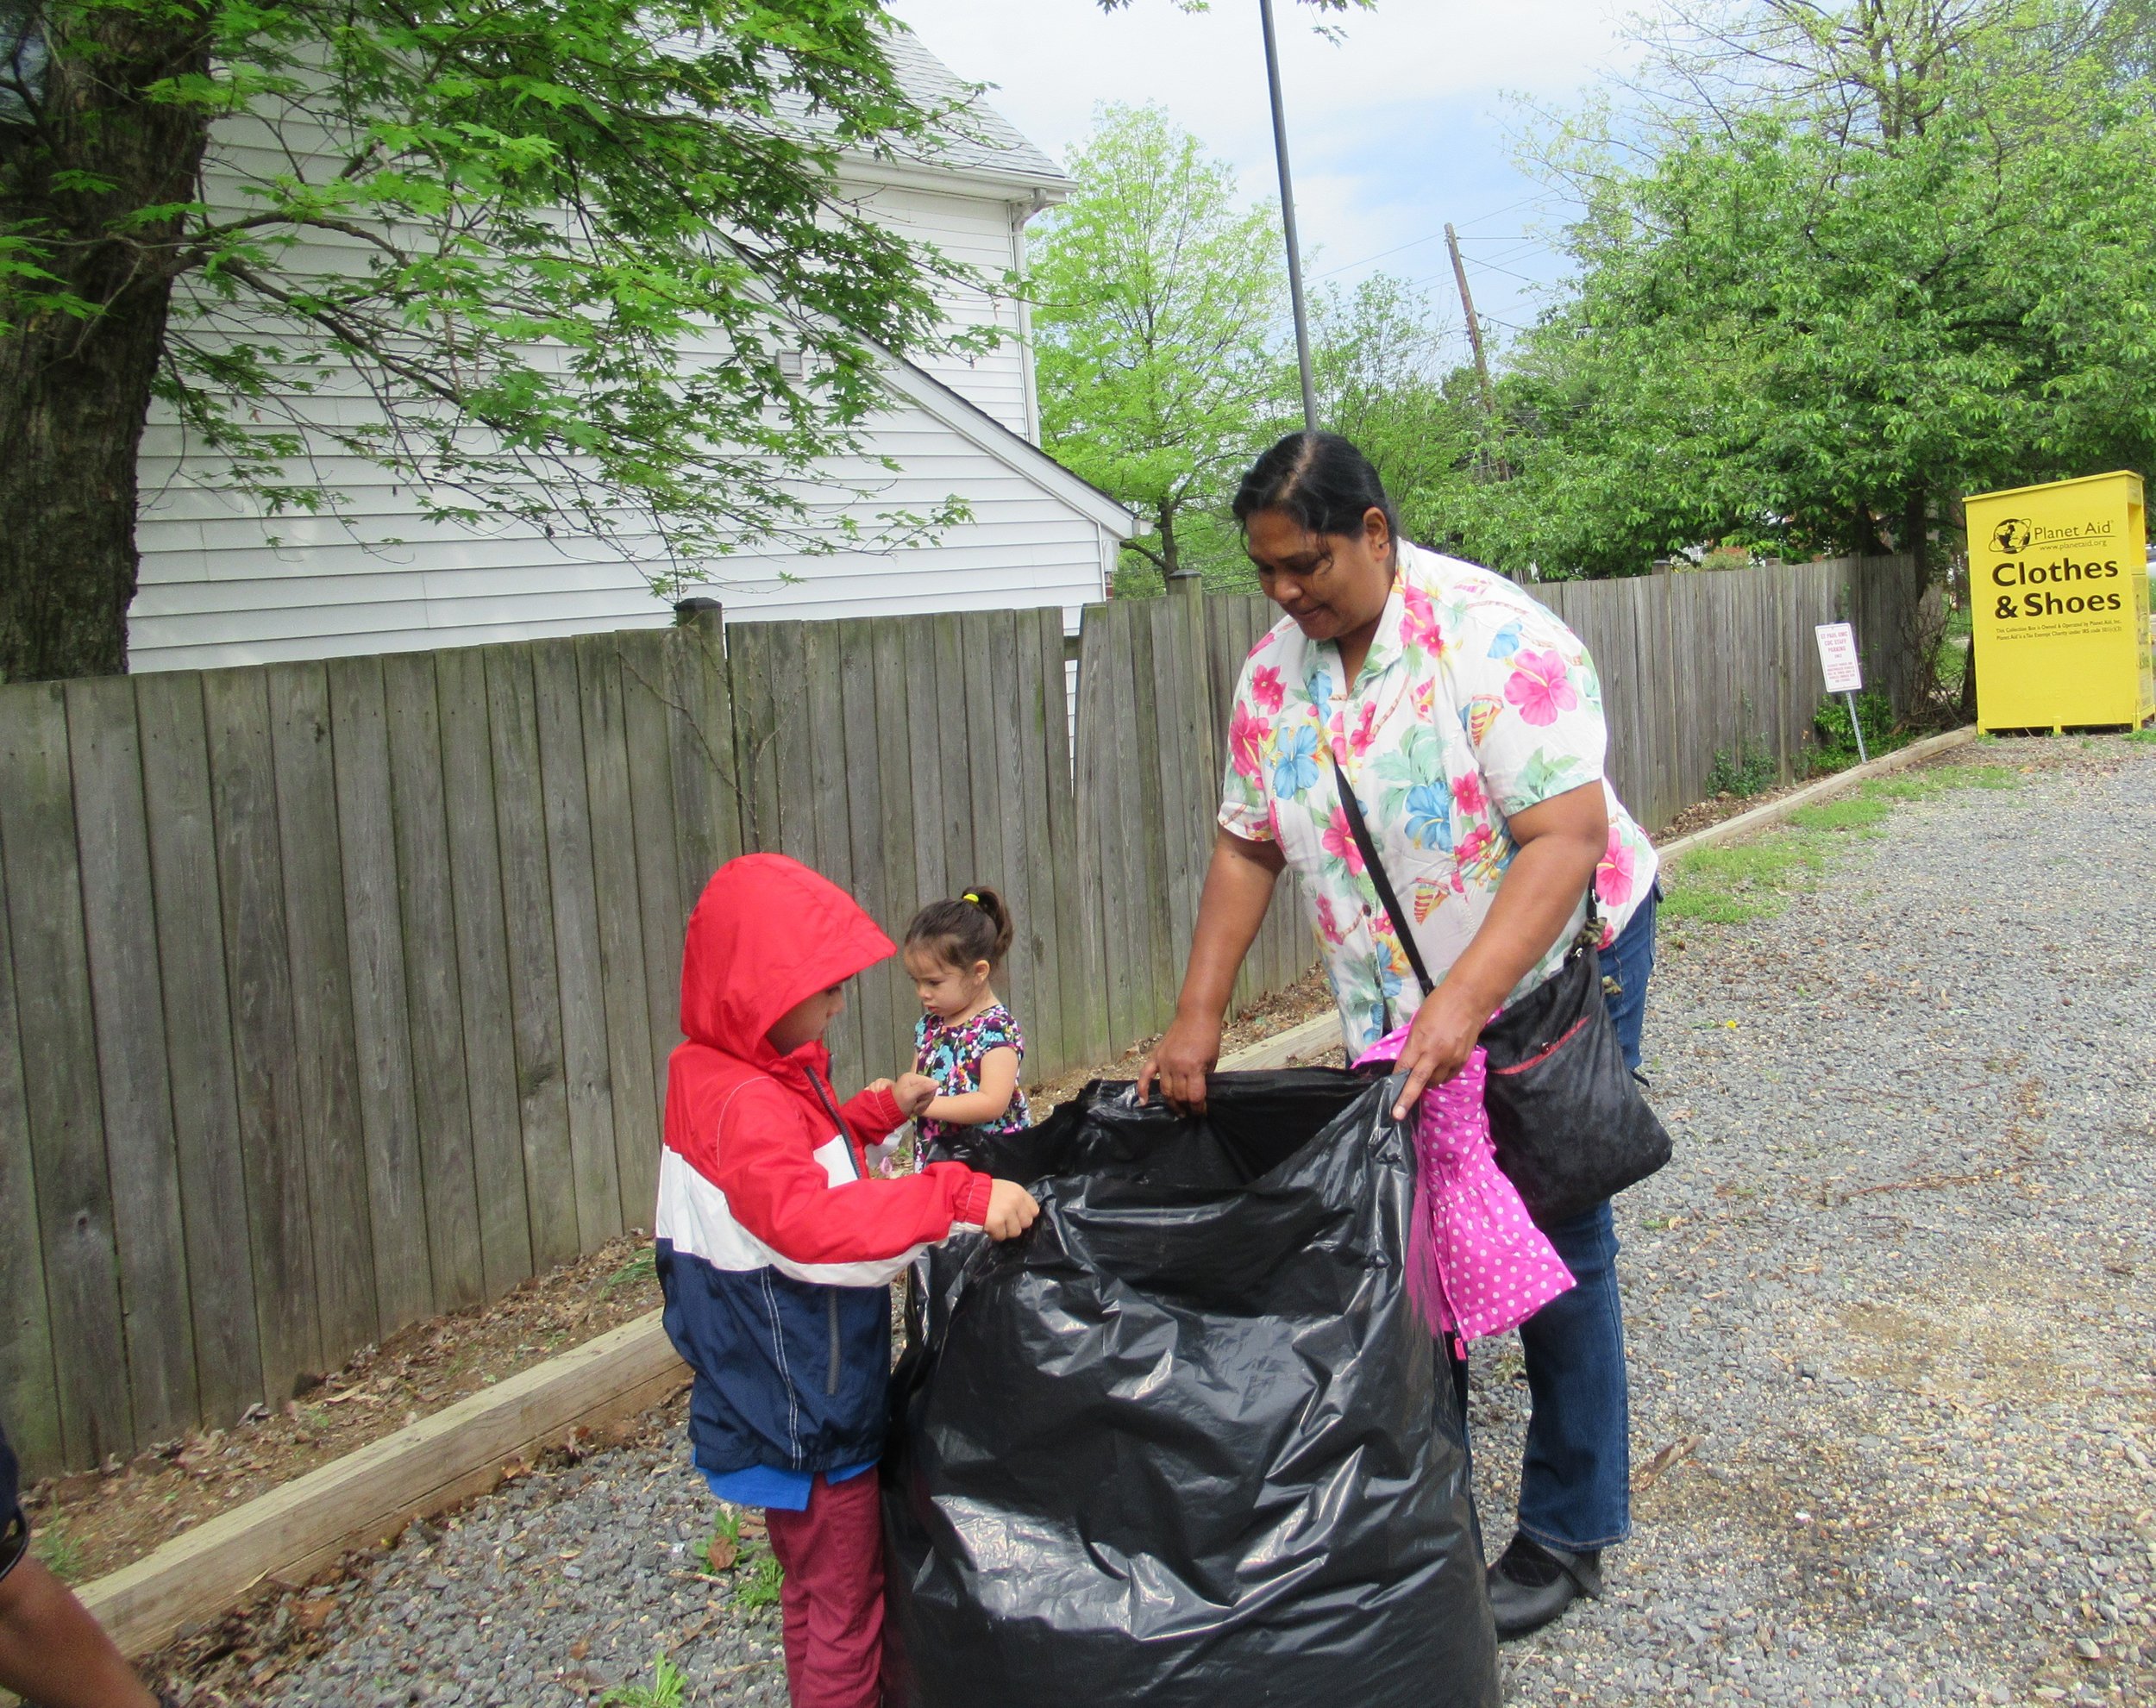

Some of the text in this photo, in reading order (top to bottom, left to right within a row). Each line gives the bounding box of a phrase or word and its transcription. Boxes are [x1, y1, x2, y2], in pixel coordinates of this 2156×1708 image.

[2034, 521, 2111, 540] Planet Aid
[2040, 540, 2108, 551] www.planetaid.org
[1992, 558, 2119, 587] Clothes
[1995, 595, 2018, 619] &
[2024, 592, 2122, 617] Shoes
